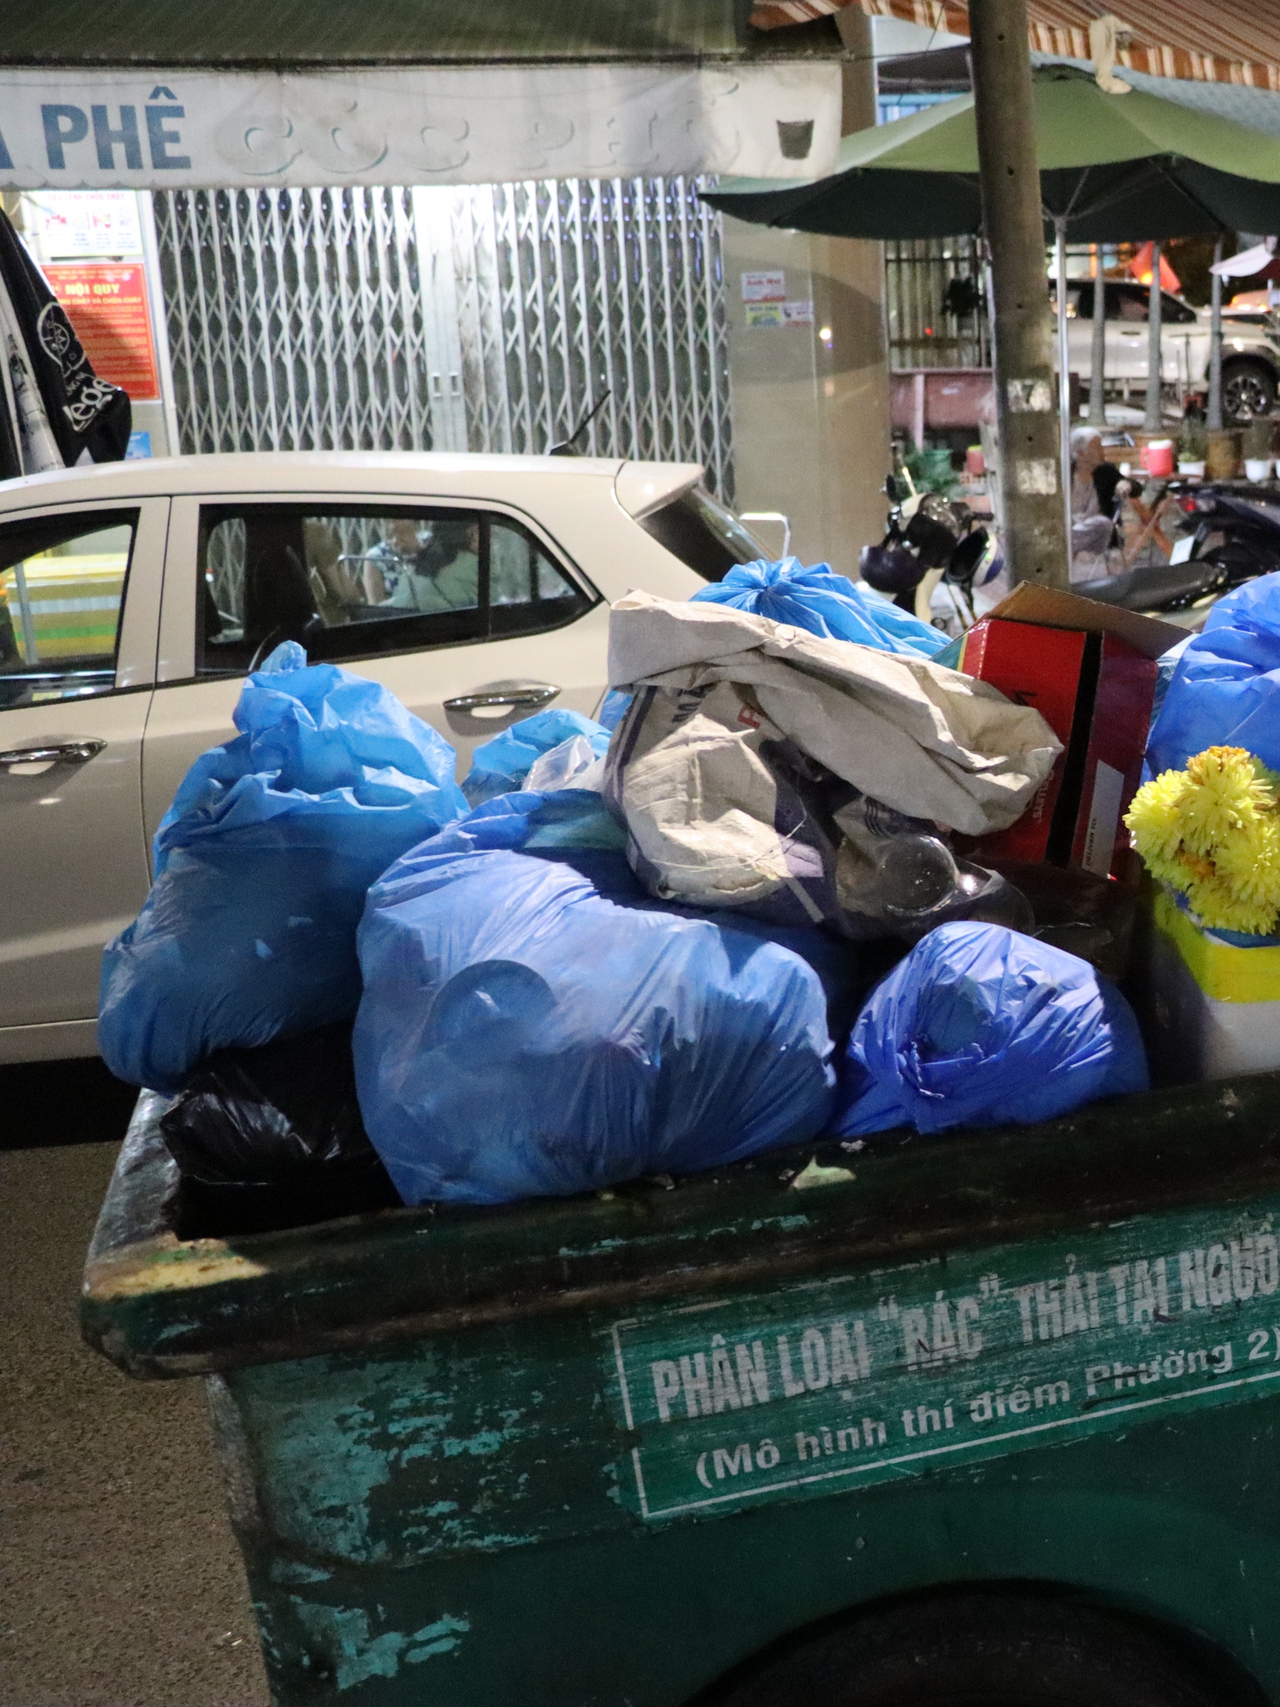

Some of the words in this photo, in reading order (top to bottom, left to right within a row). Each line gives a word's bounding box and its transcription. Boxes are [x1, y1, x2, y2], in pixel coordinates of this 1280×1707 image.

[40, 86, 191, 170] PHÊ
[65, 282, 90, 297] NỘI
[93, 283, 120, 296] QUY
[651, 1334, 770, 1423] PHÂN
[777, 1319, 872, 1401] LOẠI
[1013, 1253, 1099, 1344] THẢI
[1108, 1257, 1167, 1335] TẠI
[696, 1438, 781, 1488] (Mô
[795, 1417, 888, 1460] hình
[902, 1398, 954, 1437] thí
[969, 1375, 1071, 1423] điểm
[1084, 1340, 1234, 1398] Phường
